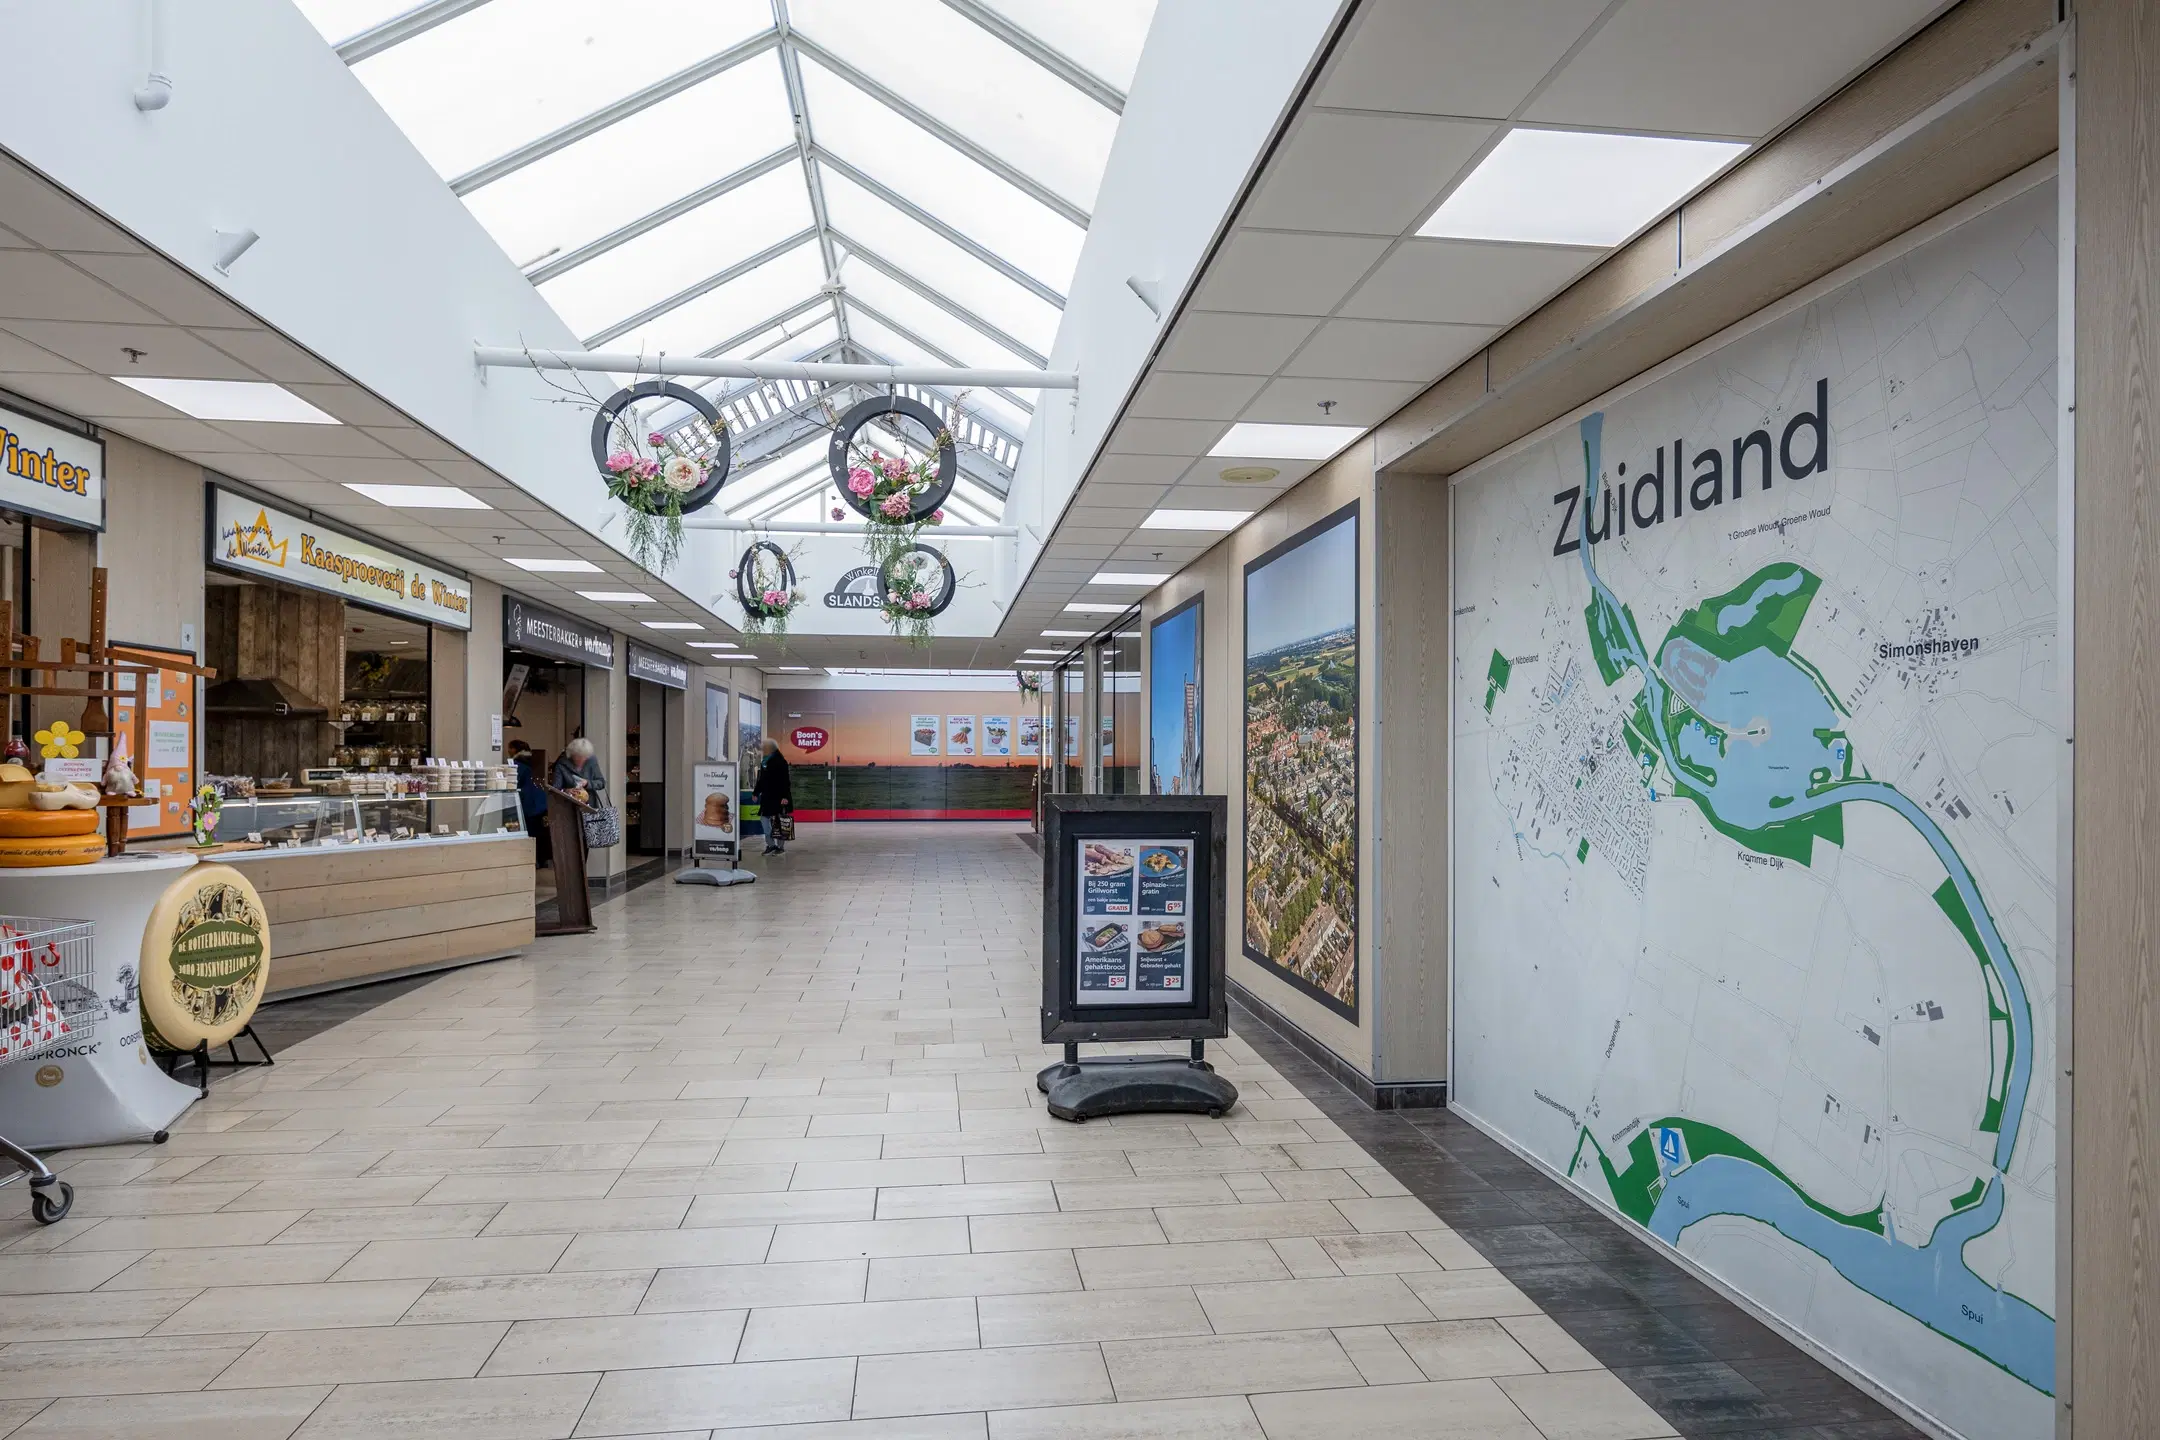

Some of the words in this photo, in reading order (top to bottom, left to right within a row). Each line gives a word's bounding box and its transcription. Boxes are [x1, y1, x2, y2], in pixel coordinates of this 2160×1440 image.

[0, 426, 90, 496] inter
[1554, 378, 1828, 557] Zuidland
[1781, 513, 1808, 527] Groene
[1809, 505, 1831, 519] Woud
[1733, 527, 1757, 540] Groene
[239, 540, 272, 560] Winter
[301, 533, 405, 599] Kaasproeverij
[411, 573, 426, 600] de
[431, 578, 468, 614] Winter
[526, 617, 579, 648] MEESTERBAKKER
[1879, 637, 1979, 659] Simonshaven
[796, 731, 823, 739] Boon's
[1770, 856, 1784, 870] Dijk
[178, 942, 187, 953] DE
[188, 931, 240, 951] ROTTERDAMSCHE
[241, 933, 256, 945] OUDE
[1084, 963, 1126, 971] gehaktbrood
[24, 1041, 98, 1061] PRONCK
[1677, 1195, 1690, 1210] Spui
[1961, 1304, 1984, 1325] Spui
